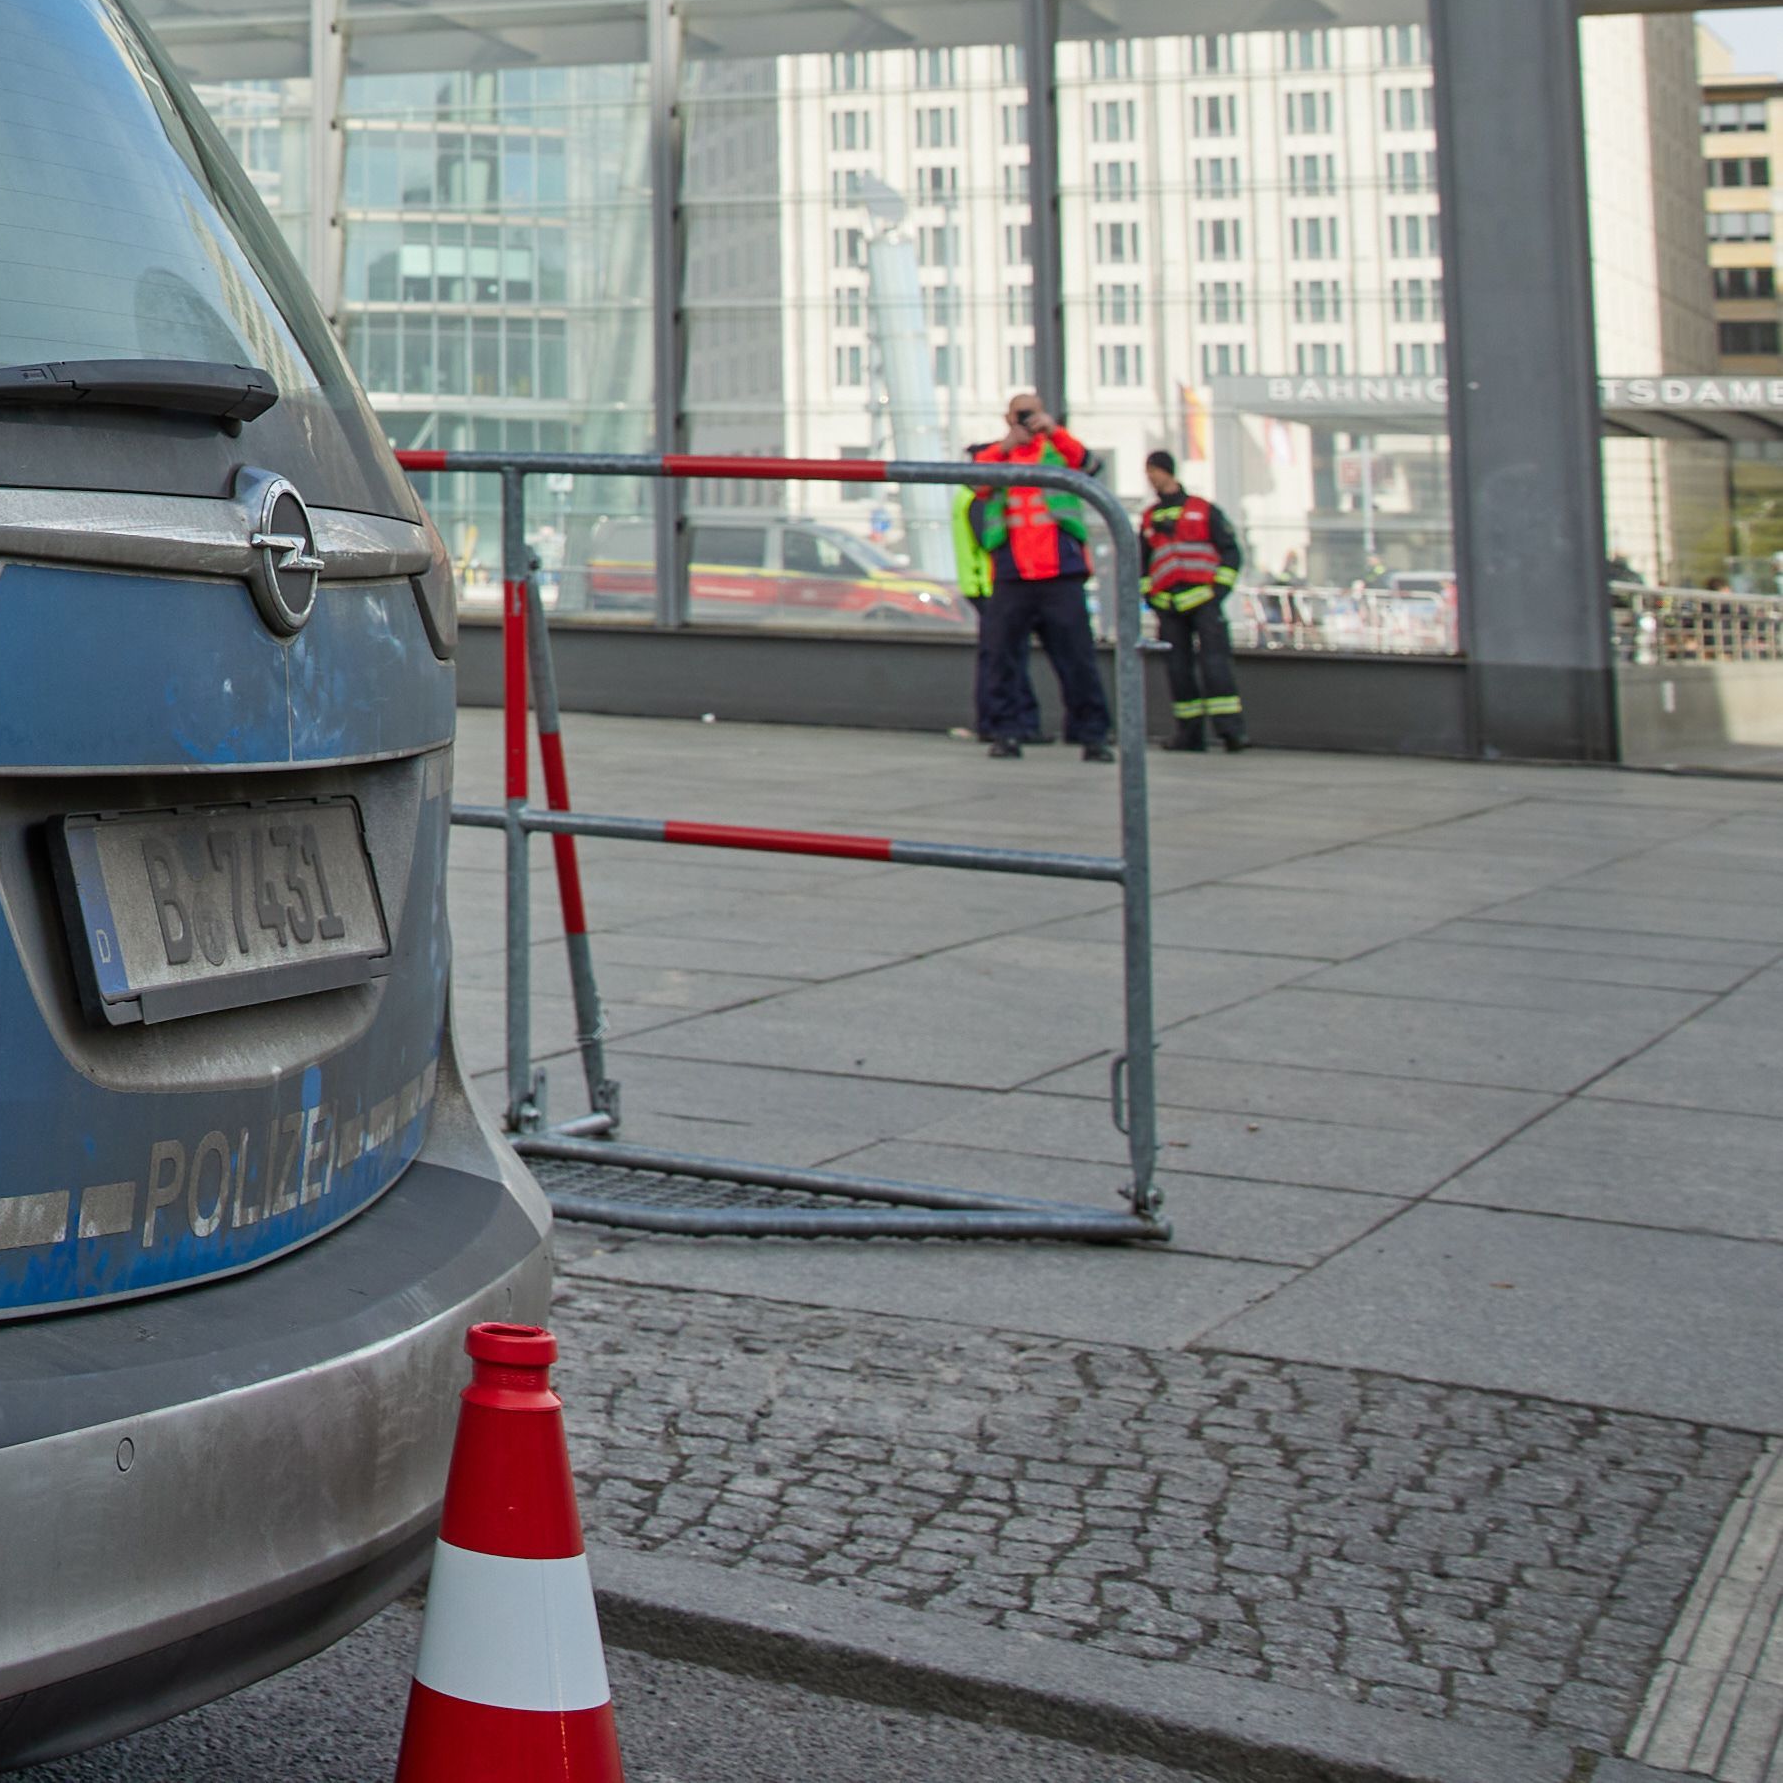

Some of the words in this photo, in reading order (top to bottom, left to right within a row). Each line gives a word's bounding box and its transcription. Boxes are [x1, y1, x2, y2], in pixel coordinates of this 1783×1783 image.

[1268, 378, 1448, 403] BAHNHO
[1598, 379, 1783, 404] TSDAME
[140, 836, 194, 966] B
[208, 823, 345, 955] 7431
[95, 928, 112, 964] D
[140, 1099, 340, 1249] POLIZEI
